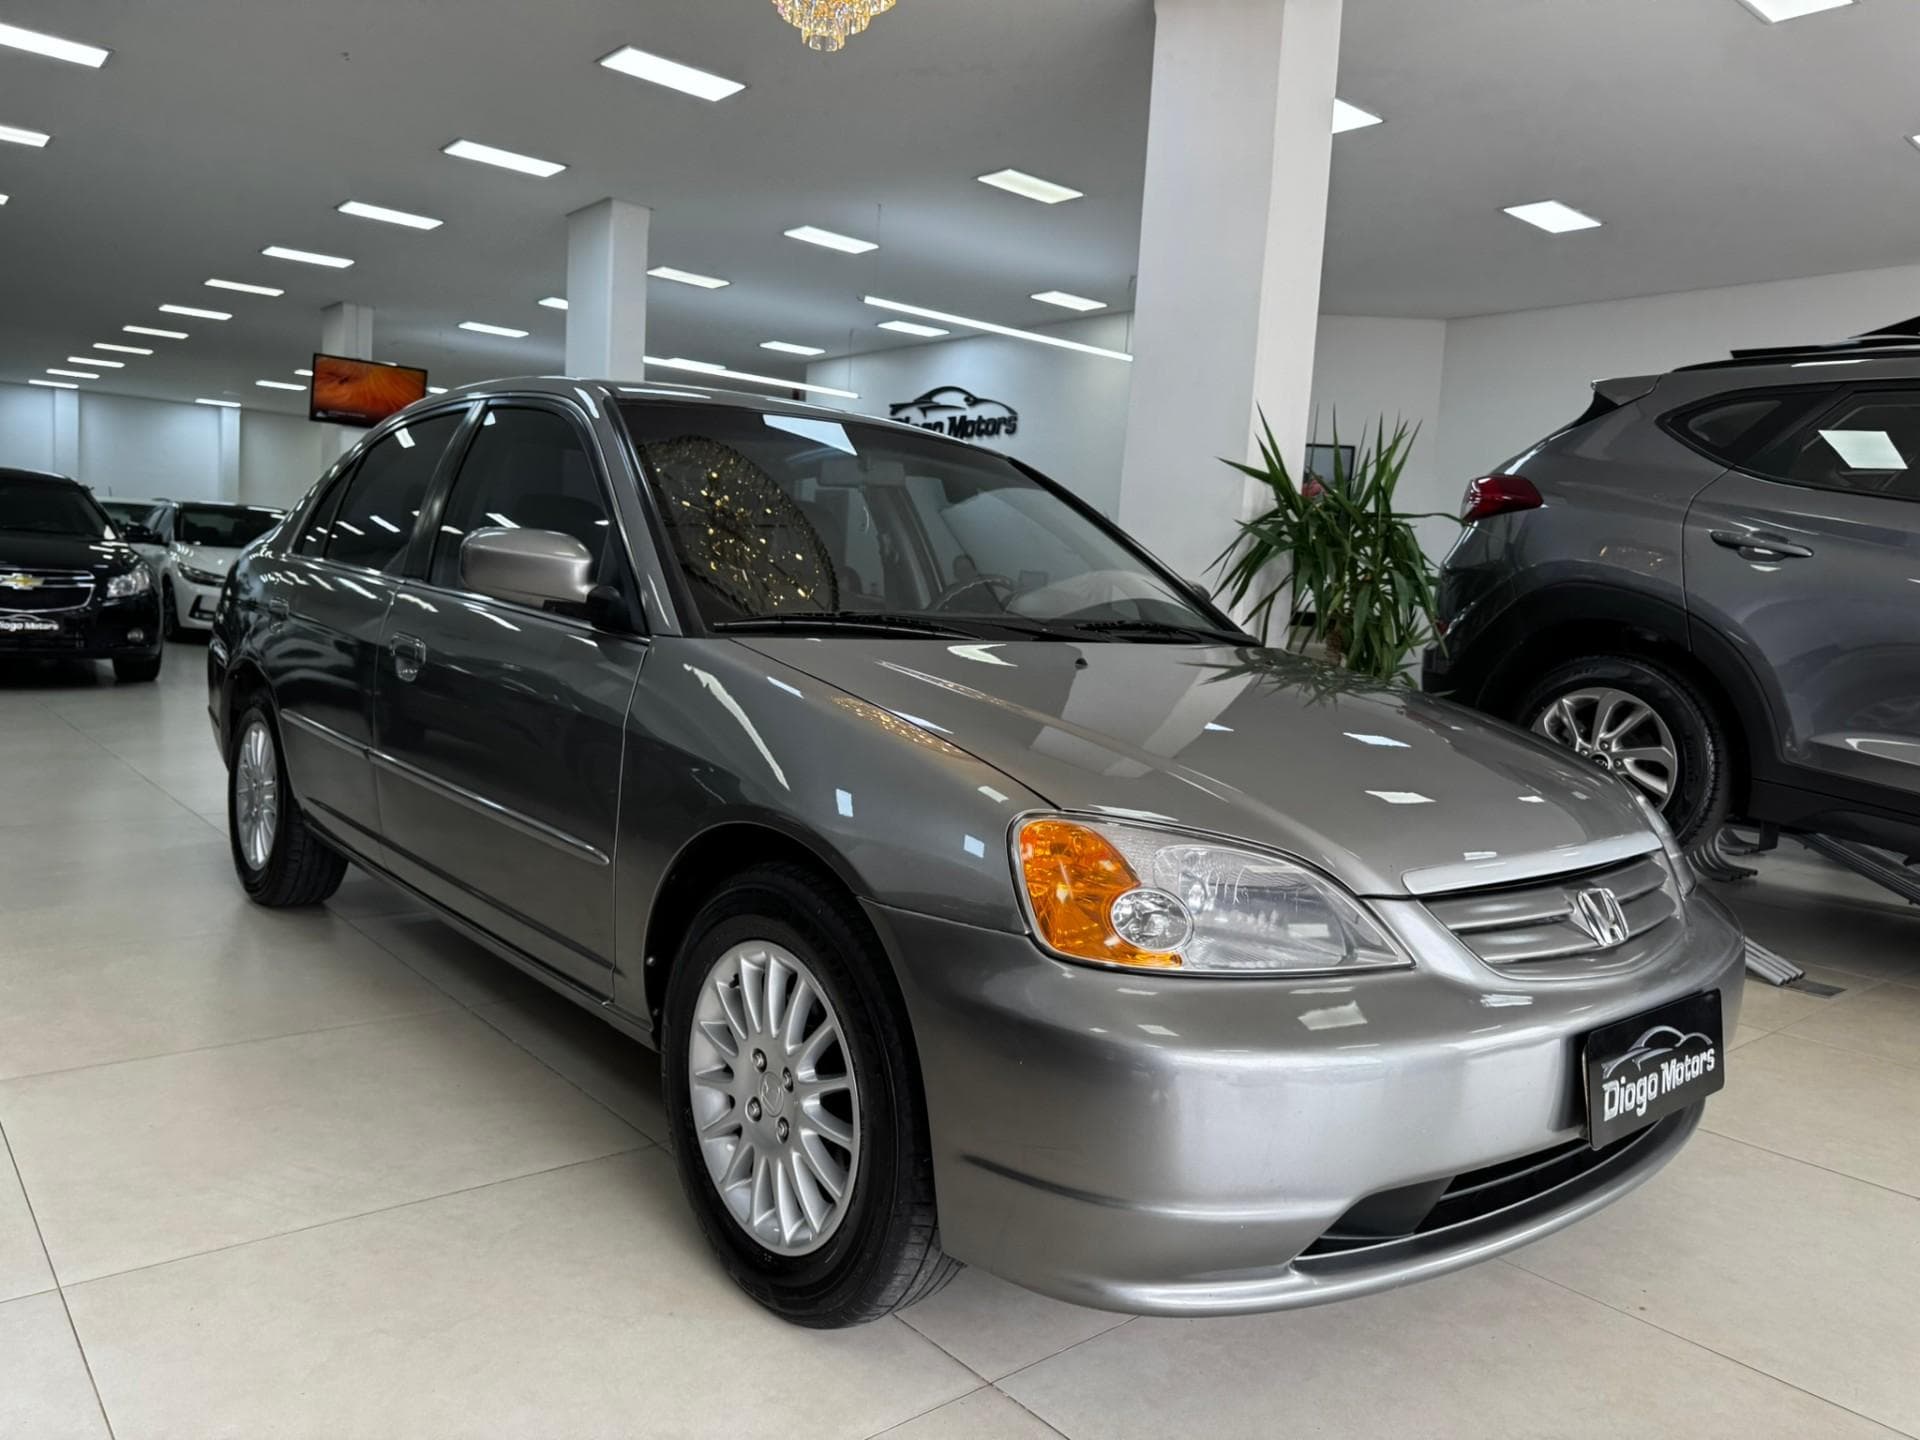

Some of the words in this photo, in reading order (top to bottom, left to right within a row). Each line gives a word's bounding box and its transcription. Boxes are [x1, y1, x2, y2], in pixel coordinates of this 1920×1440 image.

[947, 414, 1017, 438] Motors
[0, 620, 24, 632] iogo
[24, 622, 59, 631] Motors
[1602, 1076, 1658, 1122] Diogo
[1660, 1048, 1715, 1094] Motors
